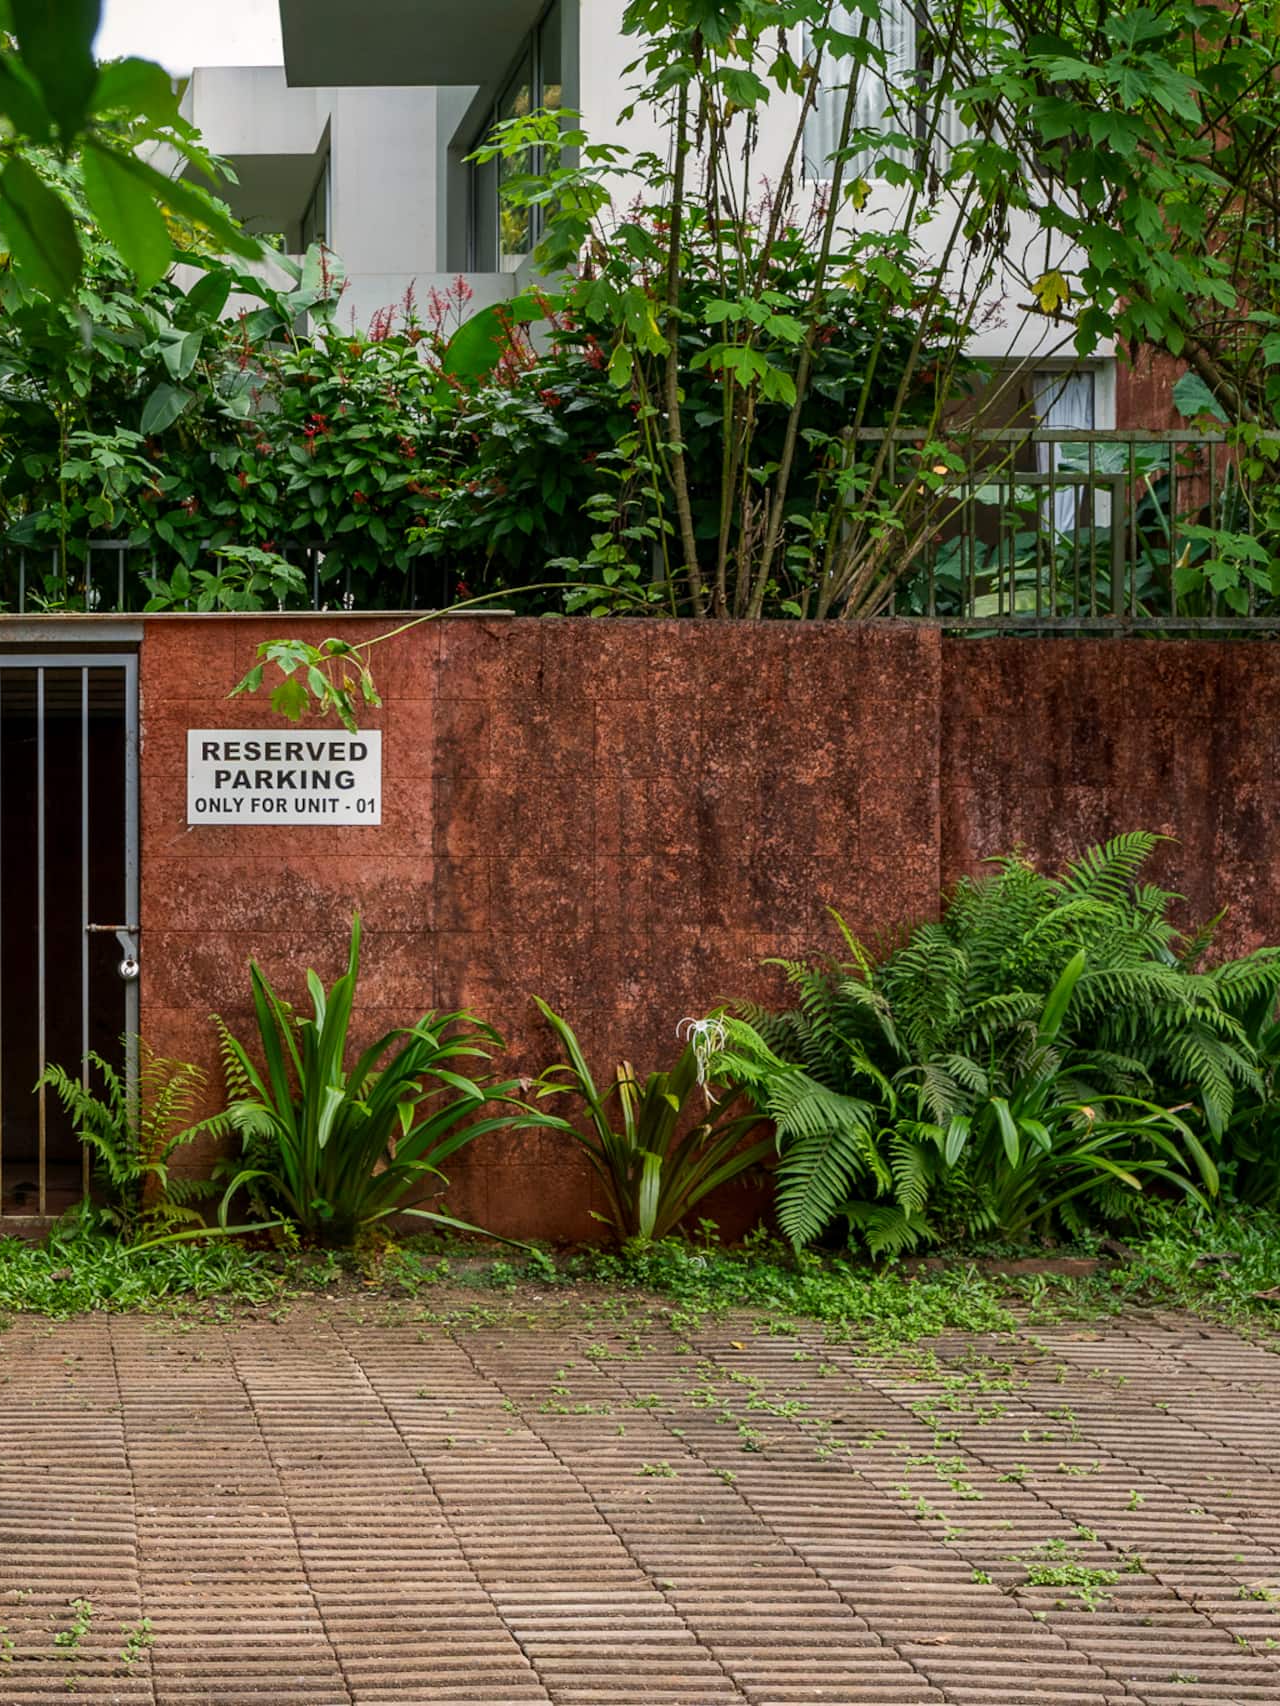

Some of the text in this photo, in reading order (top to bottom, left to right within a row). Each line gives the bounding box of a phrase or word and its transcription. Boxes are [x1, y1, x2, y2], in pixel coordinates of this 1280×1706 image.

[201, 741, 368, 762] RESERVED
[214, 769, 355, 790] PARKING
[194, 797, 245, 813] ONLY
[250, 797, 288, 813] FOR
[294, 798, 340, 813] UNIT
[356, 798, 375, 814] 01
